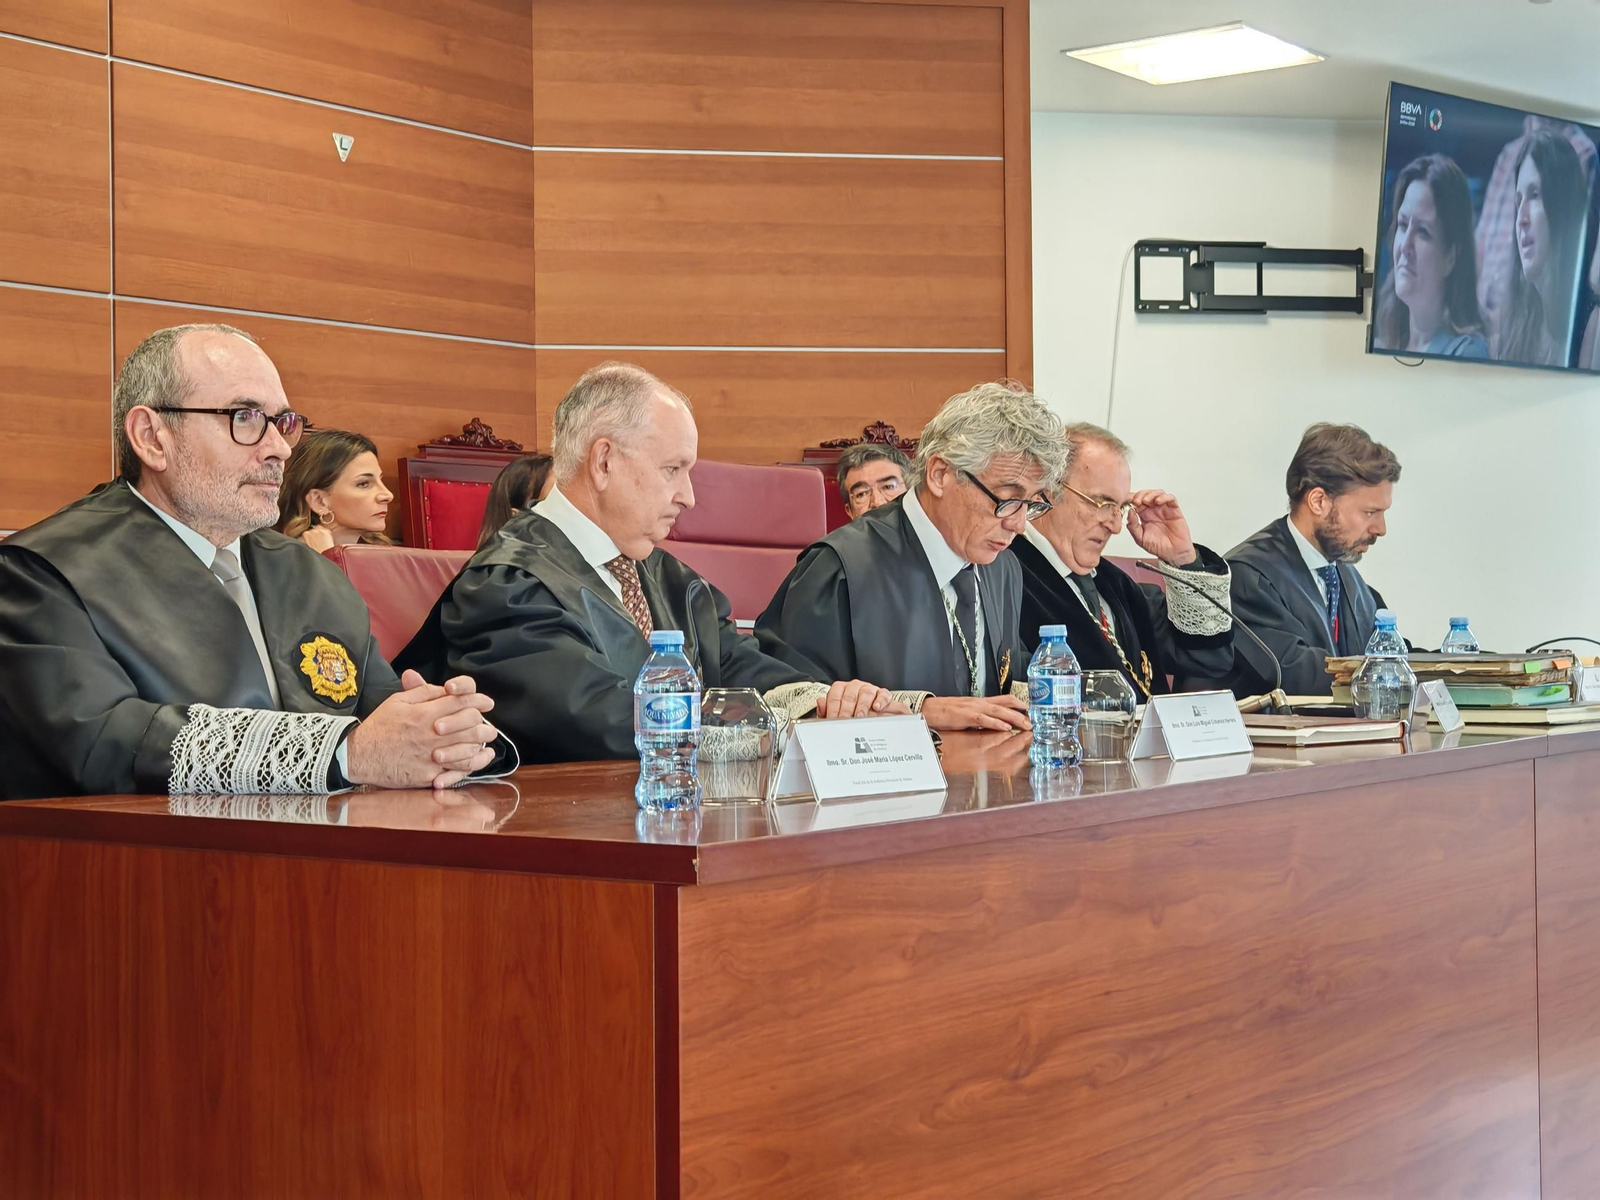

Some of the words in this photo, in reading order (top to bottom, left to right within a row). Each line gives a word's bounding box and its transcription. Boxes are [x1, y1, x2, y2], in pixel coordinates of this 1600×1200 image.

[1400, 101, 1422, 115] BBVA
[340, 137, 348, 151] L
[849, 757, 861, 765] Don
[861, 755, 874, 764] José
[888, 754, 904, 763] López
[904, 753, 923, 761] Cervilla
